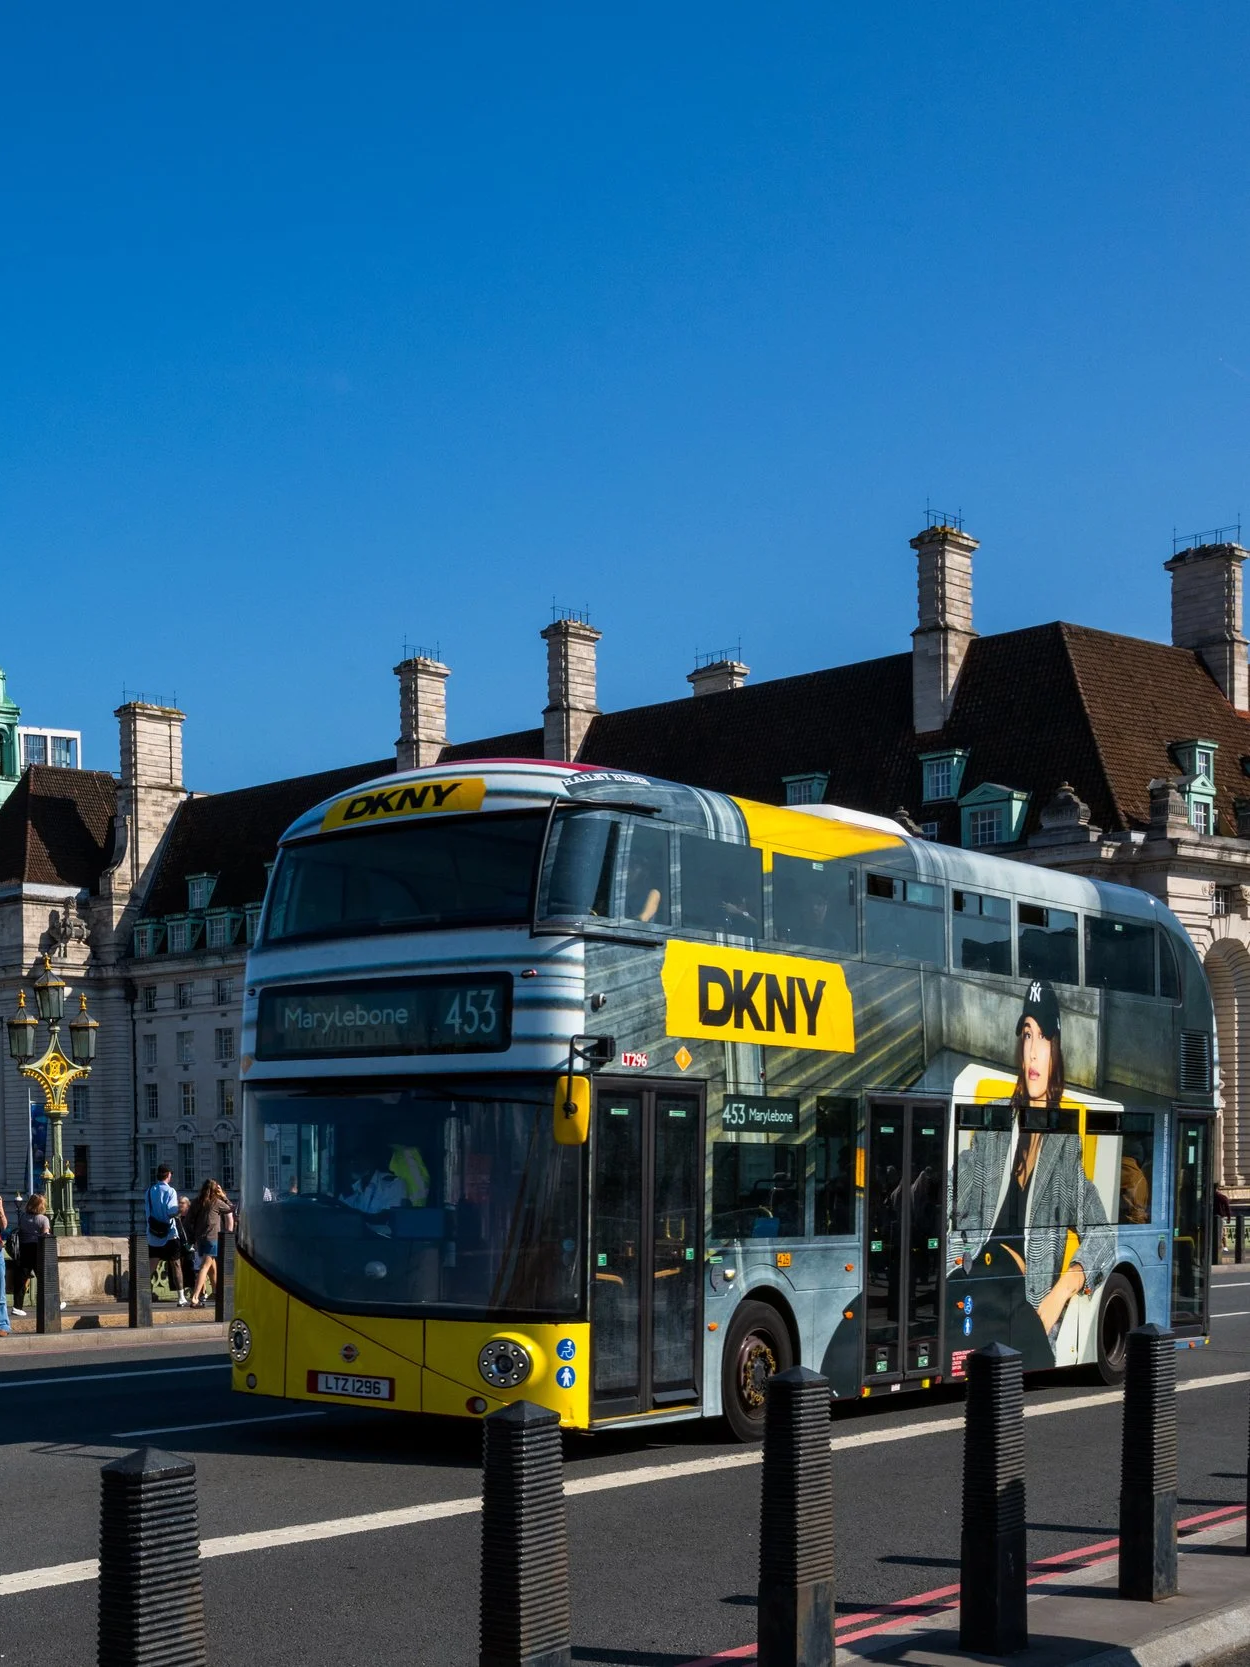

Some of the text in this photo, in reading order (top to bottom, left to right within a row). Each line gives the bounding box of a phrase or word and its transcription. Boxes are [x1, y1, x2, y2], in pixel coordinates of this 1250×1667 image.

[562, 772, 611, 786] HAILEY
[343, 783, 463, 820] DKNY
[698, 964, 827, 1036] DKNY
[284, 989, 498, 1035] Marylebone 453
[621, 1052, 648, 1067] LT296
[722, 1103, 794, 1125] 453 Marylebone
[325, 1376, 381, 1395] LTZ 1296
